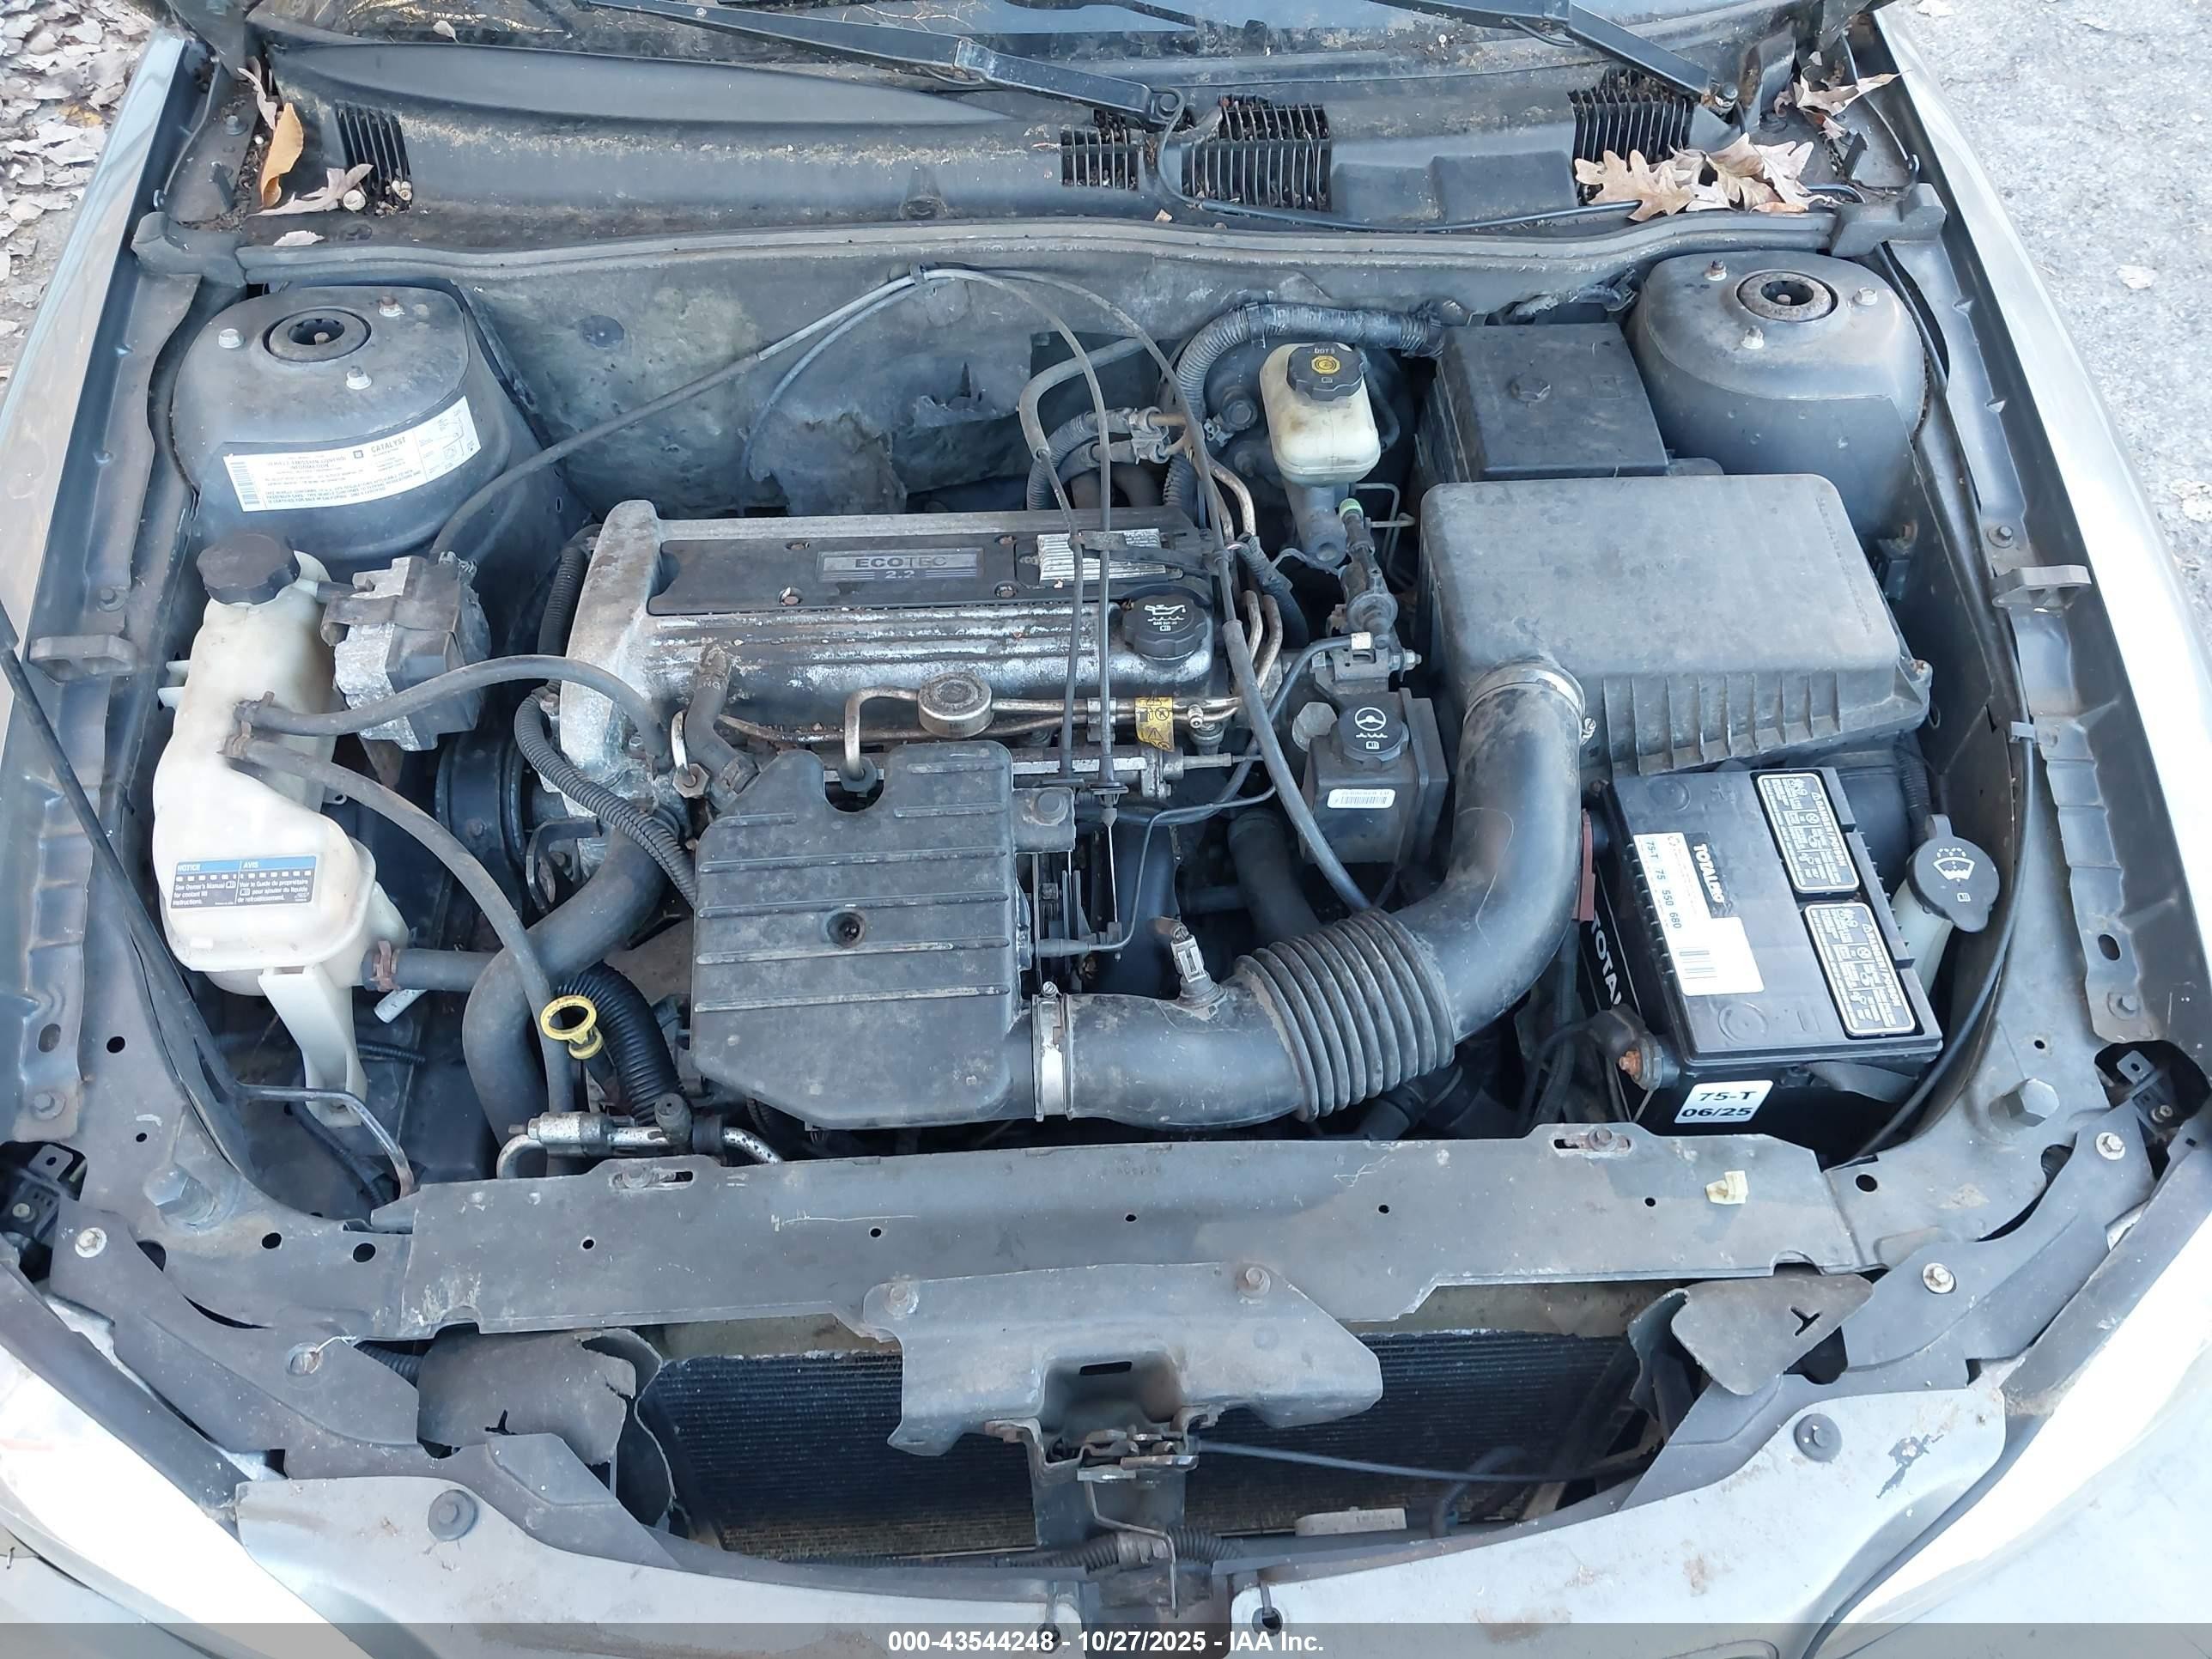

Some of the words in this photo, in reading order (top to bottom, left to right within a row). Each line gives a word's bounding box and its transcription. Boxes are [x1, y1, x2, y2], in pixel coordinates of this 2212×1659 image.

[371, 436, 406, 453] CATALYST
[855, 556, 947, 568] ECOTEC
[885, 570, 915, 579] 2.2
[1646, 841, 1659, 860] 75-T
[1656, 868, 1666, 880] 75
[1662, 890, 1674, 907] 550
[1669, 911, 1682, 929] 680
[1698, 1091, 1758, 1102] 75-T
[1681, 1108, 1753, 1117] 06/25
